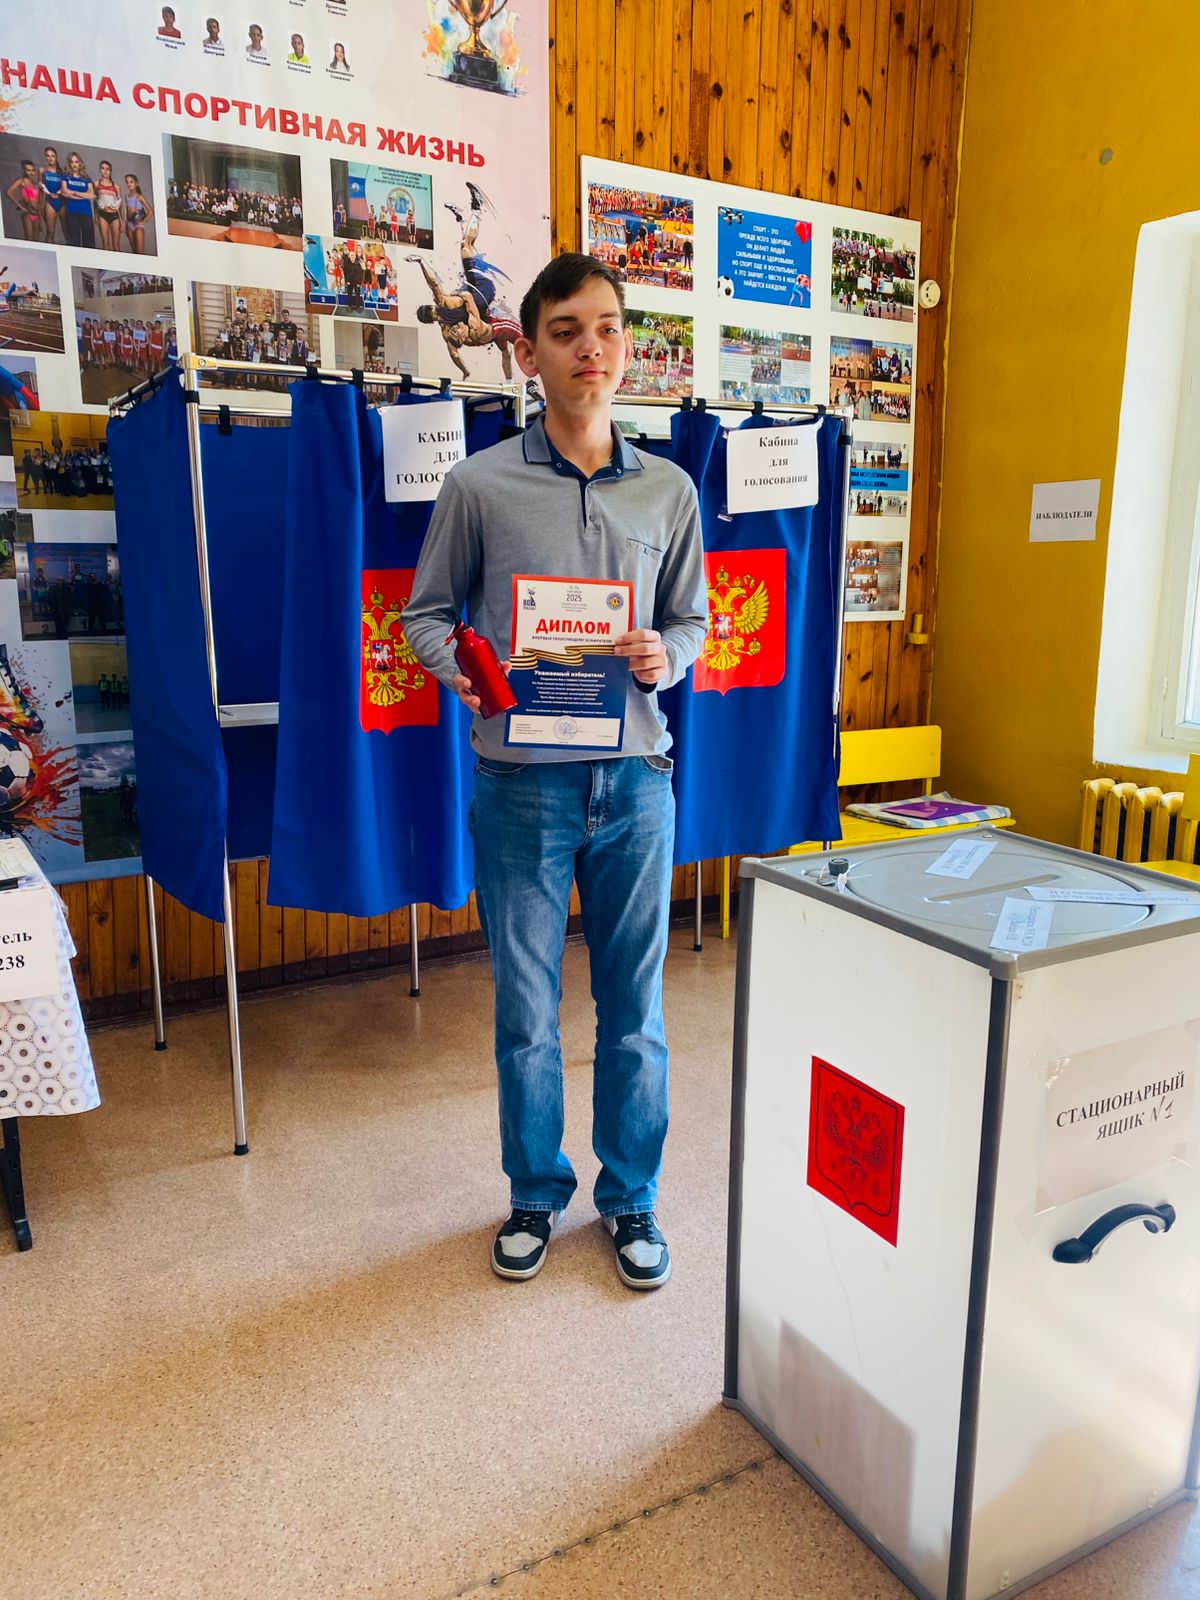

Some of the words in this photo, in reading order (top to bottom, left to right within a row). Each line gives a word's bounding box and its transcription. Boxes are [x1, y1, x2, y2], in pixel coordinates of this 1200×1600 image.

[1, 57, 121, 104] НАША
[131, 81, 367, 148] СПОРТИВНАЯ
[376, 125, 486, 169] ЖИЗНЬ
[759, 436, 799, 447] Кабина
[433, 450, 459, 464] ДЛЯ
[769, 458, 788, 467] для
[744, 475, 808, 487] голосования
[1036, 511, 1092, 520] НАБЛЮДАТЕЛИ
[535, 618, 611, 635] ДИПЛОМ
[0, 932, 32, 945] ель
[1056, 1071, 1185, 1128] СТАЦИОНАРНЫЙ
[1096, 1111, 1145, 1141] ЯЩИК
